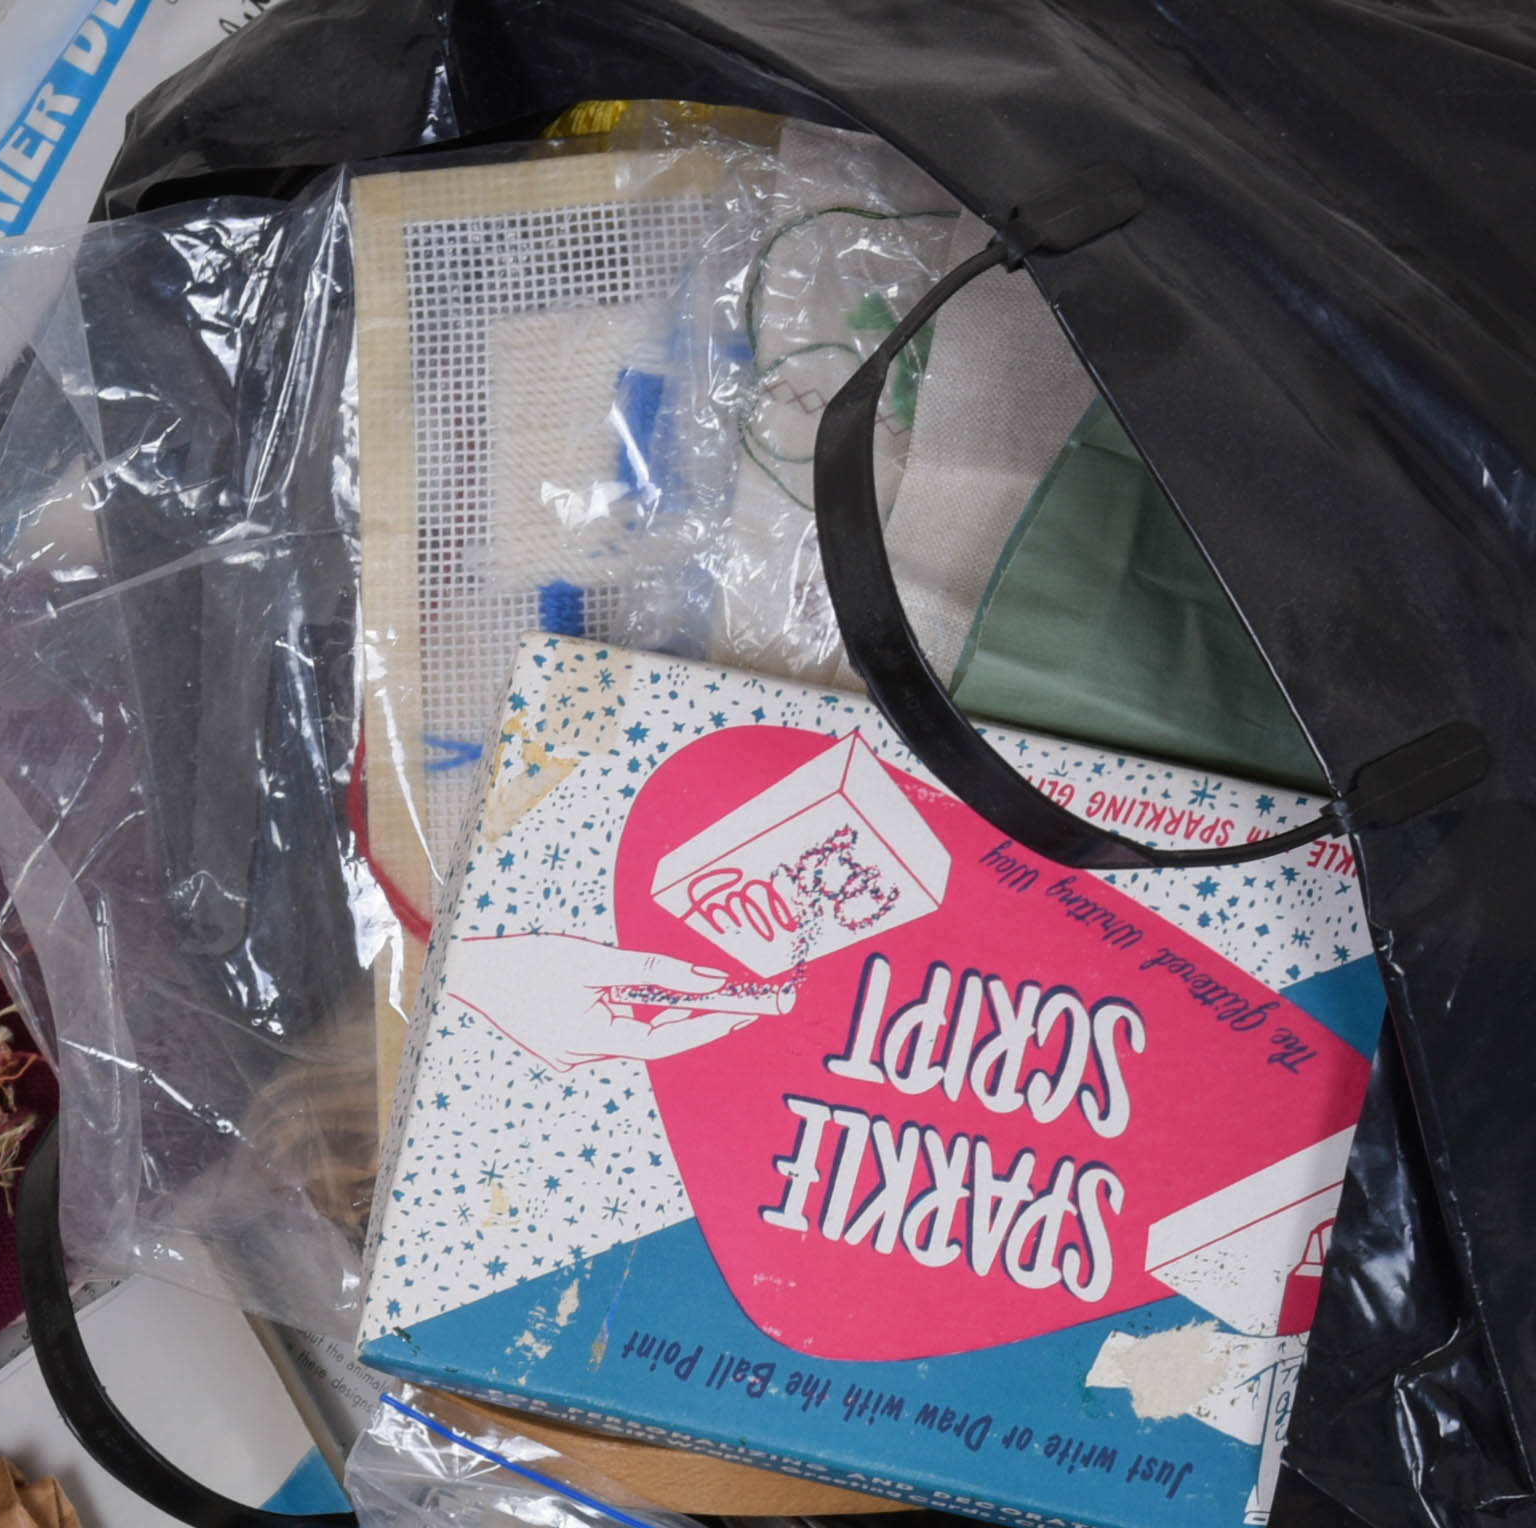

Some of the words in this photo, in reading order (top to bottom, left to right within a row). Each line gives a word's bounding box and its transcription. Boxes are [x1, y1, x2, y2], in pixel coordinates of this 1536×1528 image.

[1085, 789, 1236, 848] SPARKLING
[978, 840, 1042, 894] Way
[1045, 875, 1145, 951] Writing
[1138, 945, 1282, 1033] Glittered
[826, 951, 1147, 1141] SCRIPT
[1266, 1026, 1320, 1076] The
[762, 1093, 1128, 1304] SPARKLE
[325, 1336, 347, 1361] the
[620, 1330, 705, 1383] Point
[706, 1352, 778, 1400] Ball
[783, 1369, 834, 1412] the
[841, 1382, 905, 1426] with
[915, 1401, 993, 1453] Draw
[567, 1406, 827, 1471] PERSONALIZING
[847, 1472, 915, 1492] AND
[1002, 1423, 1035, 1452] or
[1043, 1432, 1119, 1475] write
[1128, 1452, 1194, 1499] Just
